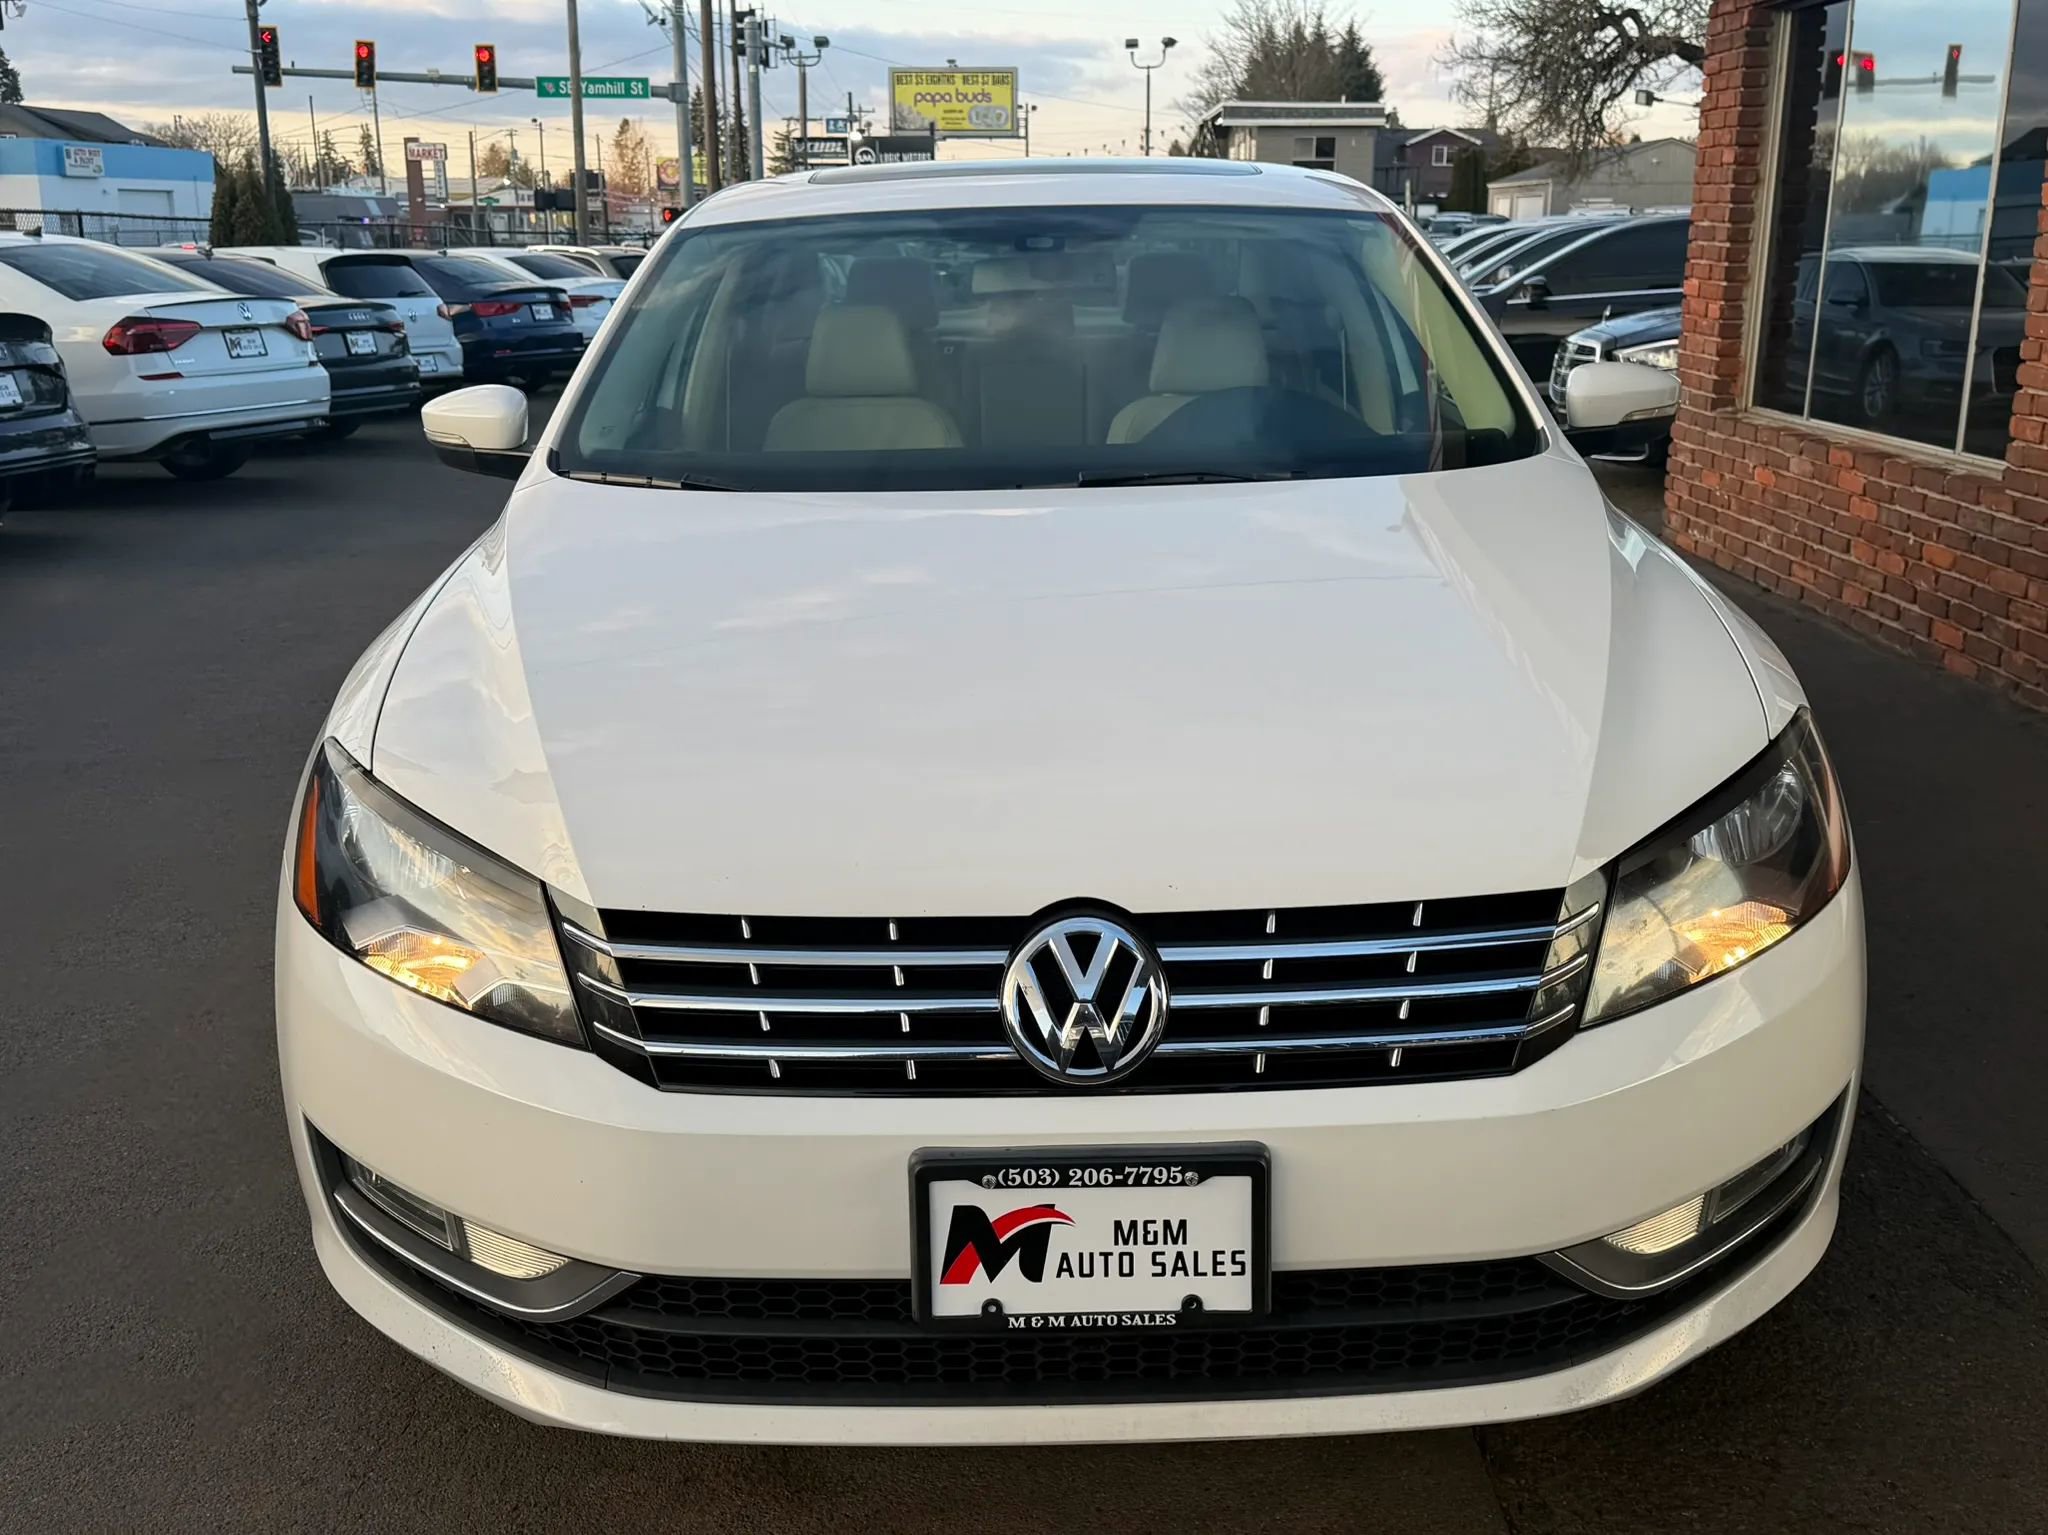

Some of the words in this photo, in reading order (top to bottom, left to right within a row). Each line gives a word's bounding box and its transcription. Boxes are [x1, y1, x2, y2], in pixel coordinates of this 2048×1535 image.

[580, 81, 625, 95] Yamhill
[630, 81, 643, 95] St
[896, 74, 913, 85] BEST
[914, 92, 953, 107] papa
[955, 88, 993, 103] buds
[408, 148, 444, 159] MARKET
[997, 1168, 1060, 1188] (503)
[1069, 1166, 1184, 1187] 206-7795
[1112, 1218, 1189, 1247] M&M
[1055, 1251, 1136, 1279] AUTO
[1151, 1249, 1248, 1278] SALES
[1008, 1316, 1027, 1329] M
[1031, 1316, 1045, 1328] &
[1047, 1315, 1066, 1328] M
[1070, 1314, 1119, 1327] AUTO
[1121, 1313, 1177, 1326] SALES
